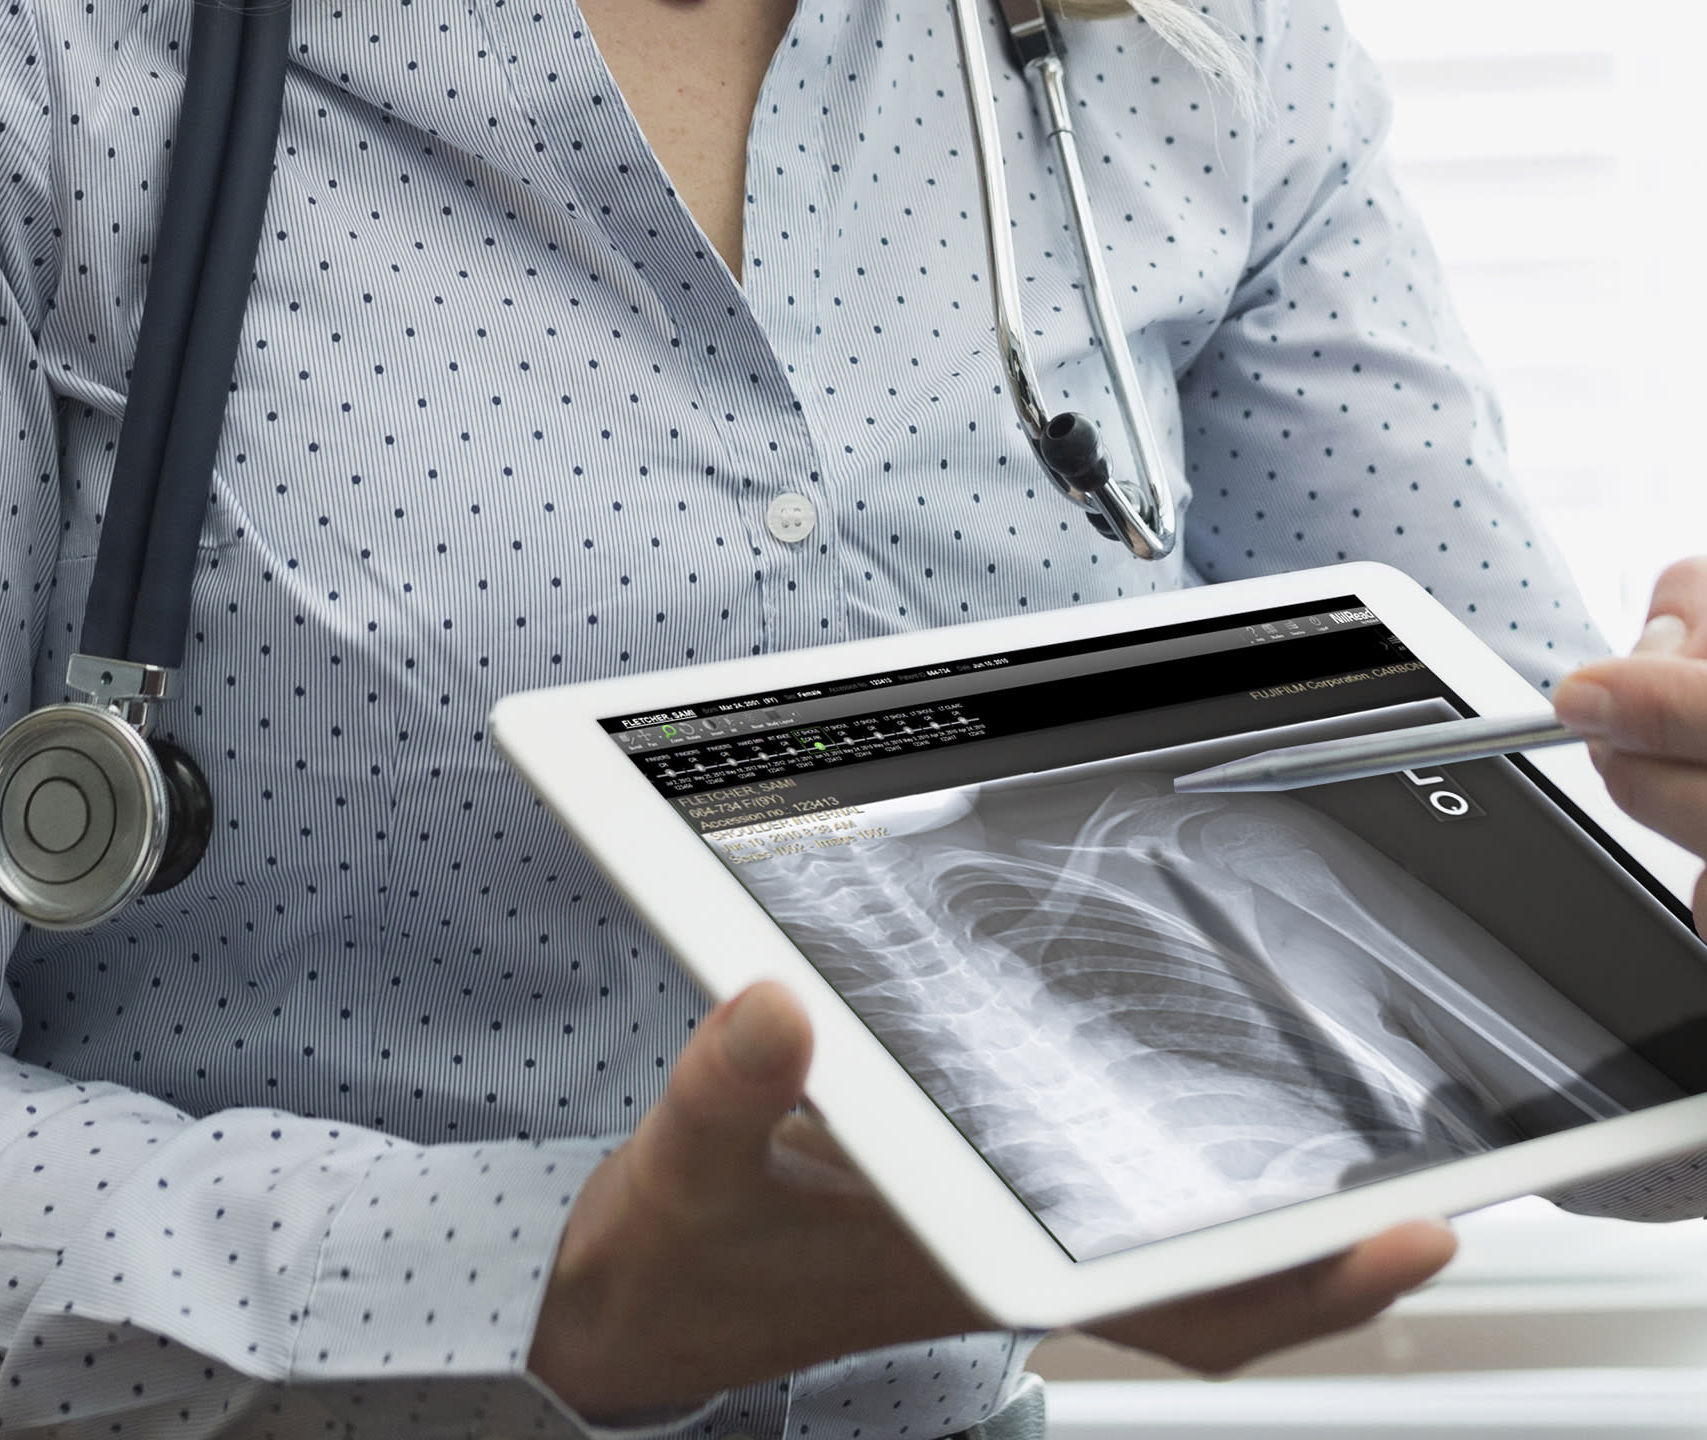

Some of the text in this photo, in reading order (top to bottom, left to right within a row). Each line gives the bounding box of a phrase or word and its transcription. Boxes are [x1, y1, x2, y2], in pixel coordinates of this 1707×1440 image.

[1329, 608, 1374, 624] NilRead
[1249, 682, 1308, 700] FUJIFILM
[1372, 661, 1426, 677] CARBON
[621, 713, 673, 728] FLETCHER,
[672, 710, 697, 721] SAMI
[797, 689, 822, 698] Female
[677, 777, 797, 807] FLETCHER, SAMI
[700, 812, 766, 830] Accession
[792, 796, 840, 812] 123413
[709, 806, 865, 841] SHOULDER INTERNAL
